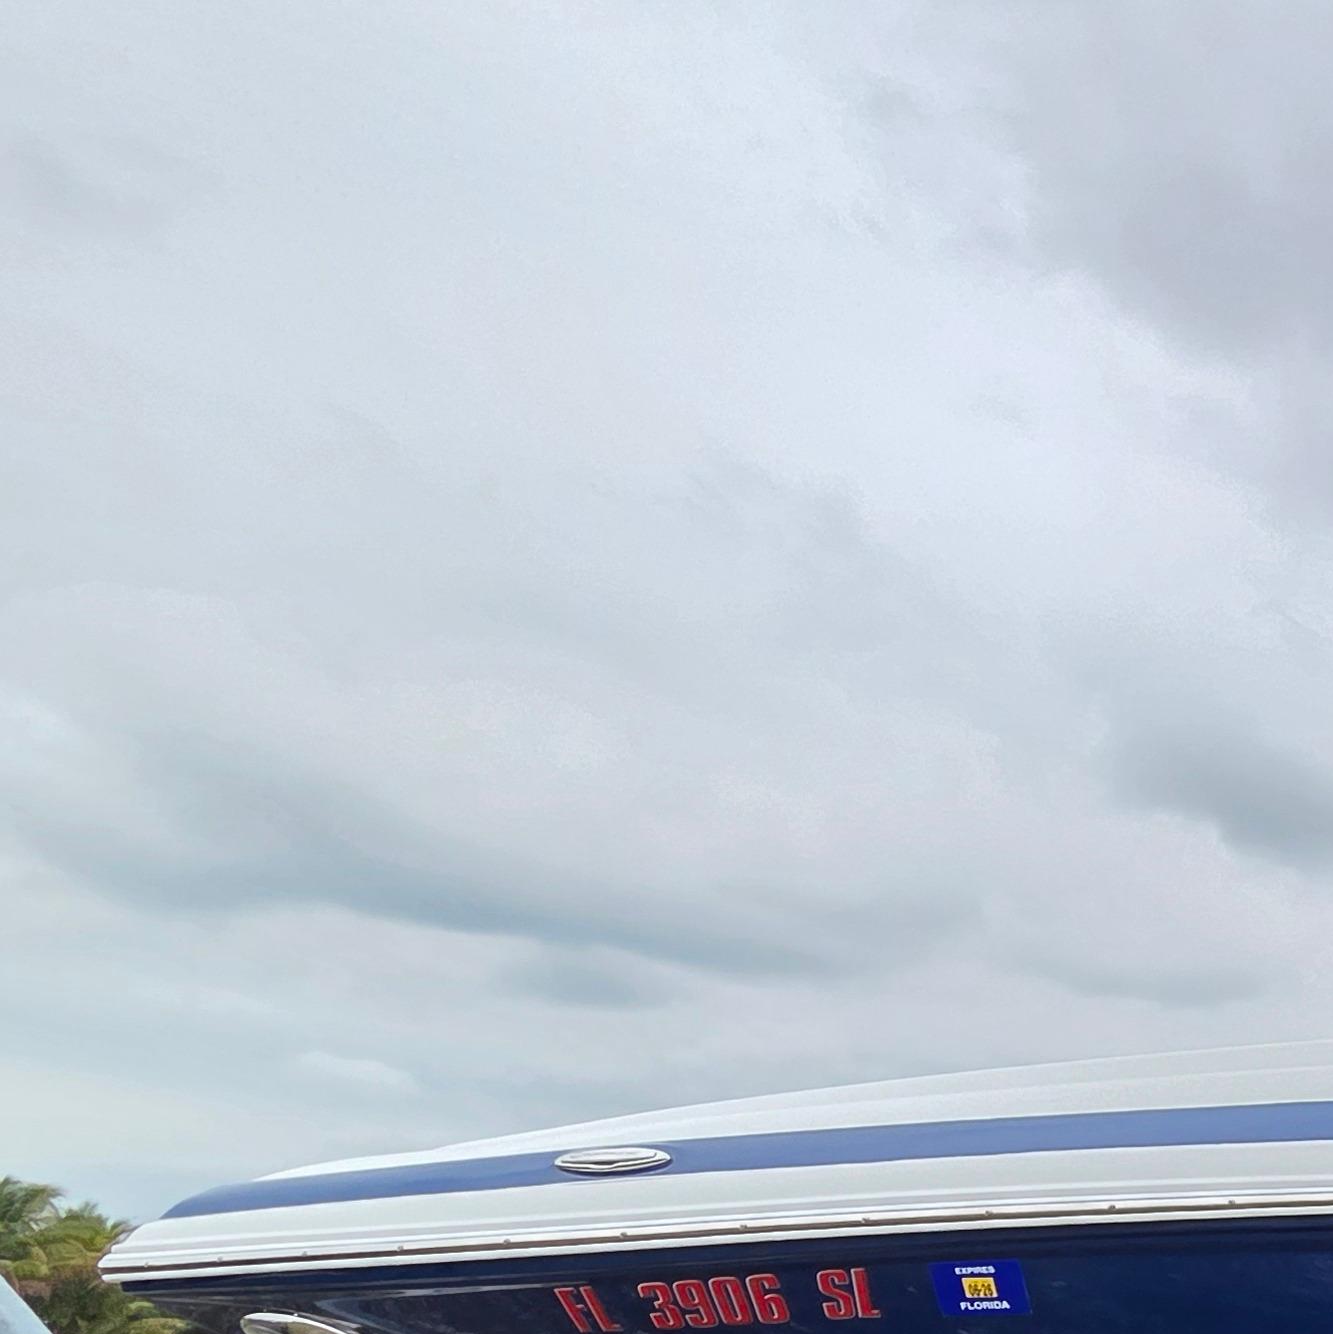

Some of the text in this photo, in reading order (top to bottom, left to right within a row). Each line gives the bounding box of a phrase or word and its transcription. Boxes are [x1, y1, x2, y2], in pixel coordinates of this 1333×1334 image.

[954, 1265, 996, 1275] EXPIRES
[553, 1267, 882, 1334] FL 3906 SL
[959, 1300, 1011, 1311] FLORIDA
